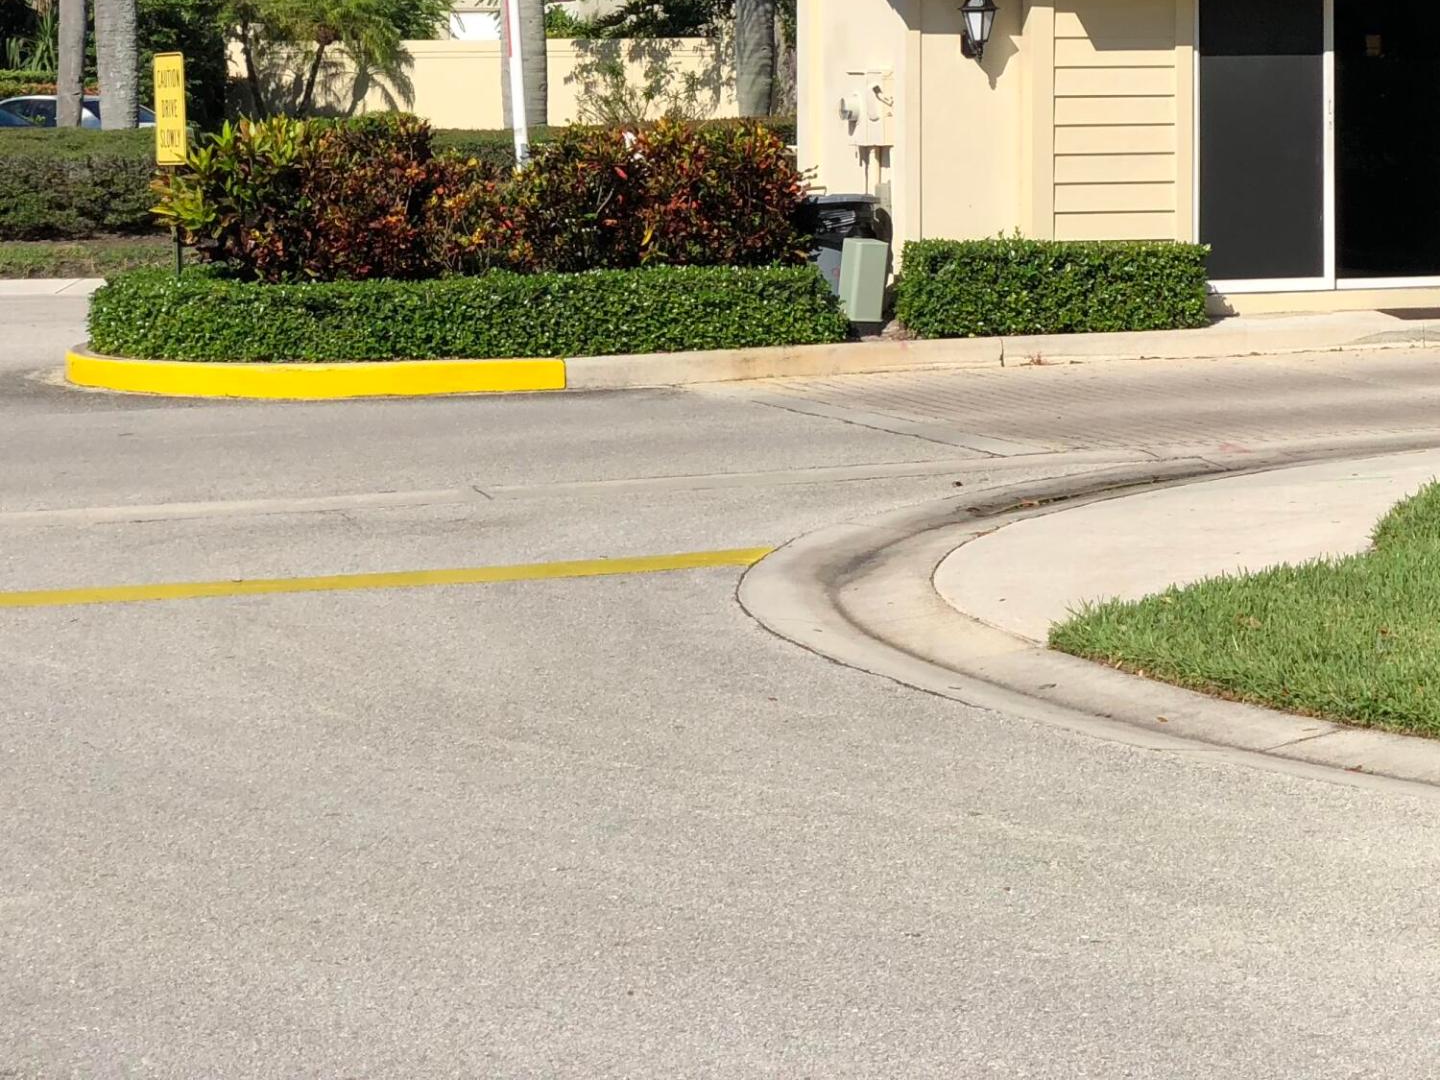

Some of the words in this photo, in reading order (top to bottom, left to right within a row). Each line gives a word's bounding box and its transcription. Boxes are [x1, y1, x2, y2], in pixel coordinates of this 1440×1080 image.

[157, 69, 181, 88] CAUTION
[161, 99, 178, 118] DRIVE
[160, 129, 181, 148] SLOWLY
